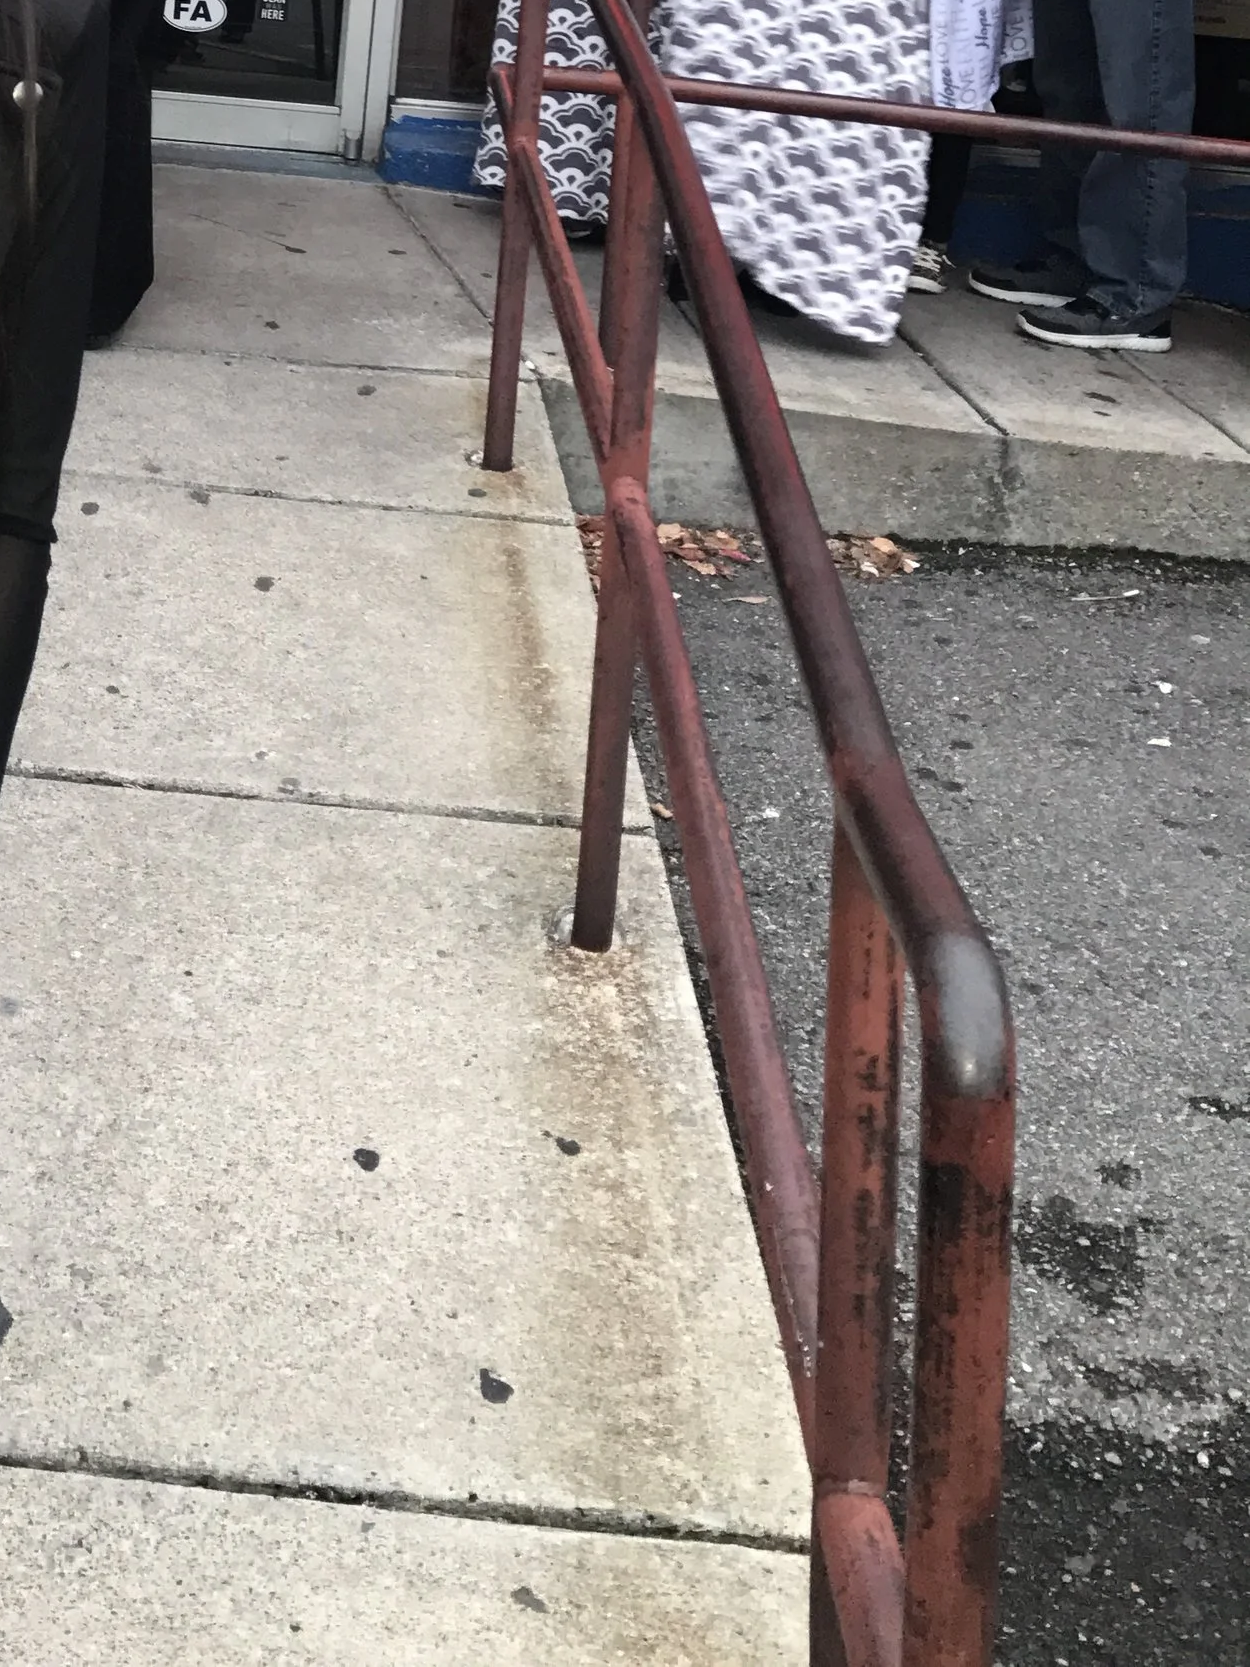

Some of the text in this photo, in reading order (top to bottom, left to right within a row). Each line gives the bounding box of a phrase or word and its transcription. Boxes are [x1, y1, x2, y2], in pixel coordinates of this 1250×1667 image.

[261, 9, 285, 21] HERE
[974, 7, 992, 50] Hope
[938, 66, 960, 108] Hope
